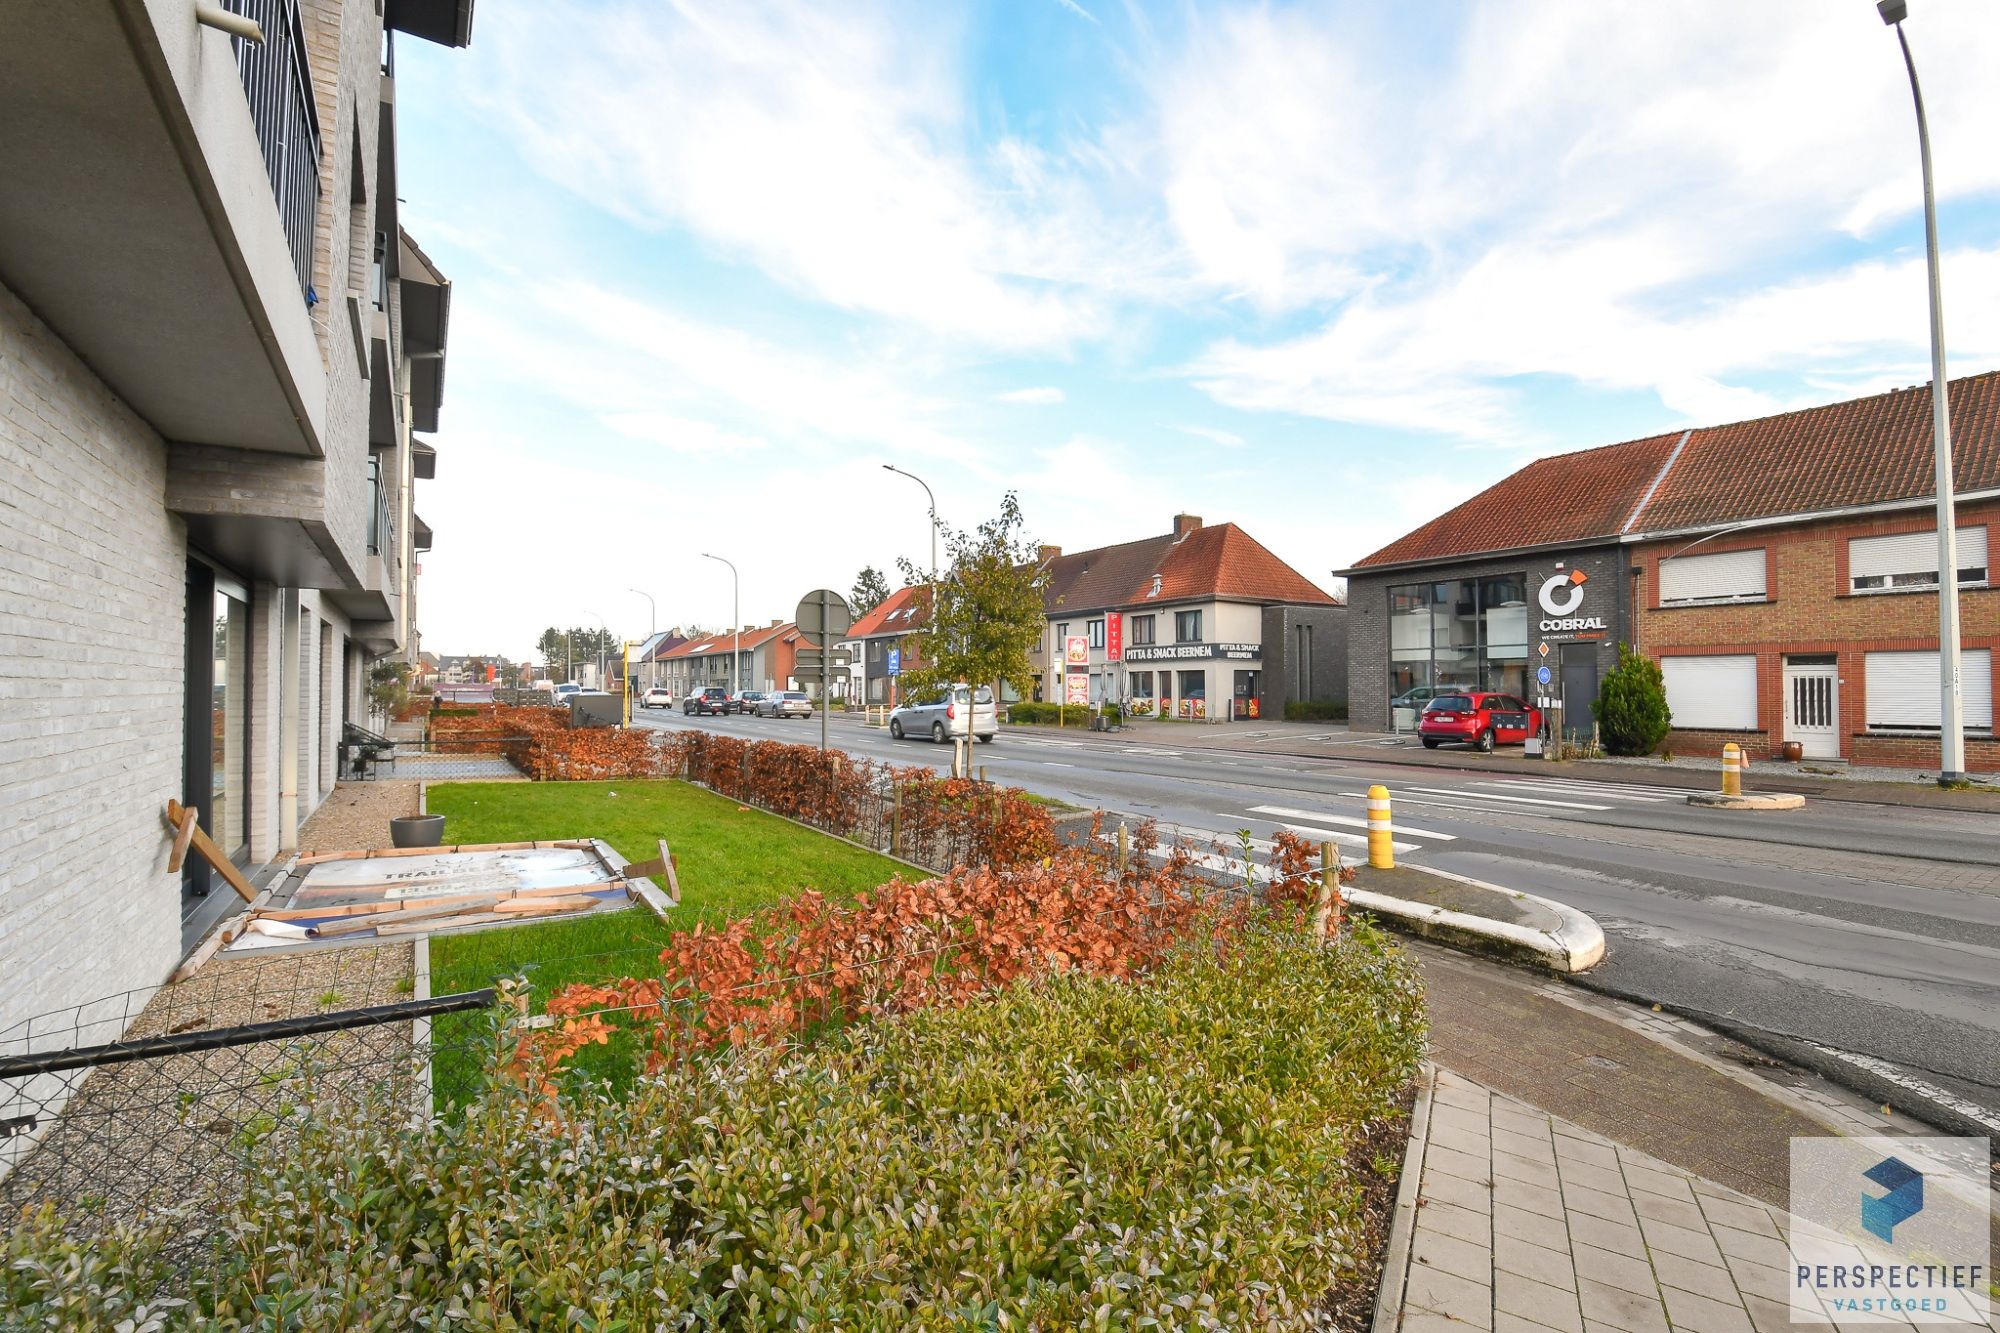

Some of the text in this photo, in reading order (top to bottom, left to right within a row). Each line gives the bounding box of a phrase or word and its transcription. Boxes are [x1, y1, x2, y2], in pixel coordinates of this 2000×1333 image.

[1539, 617, 1608, 632] COBRAL
[1110, 614, 1118, 654] PITTA
[1126, 645, 1213, 660] PITTA & SNACK BEERNEM
[1227, 651, 1253, 659] BEERNEM
